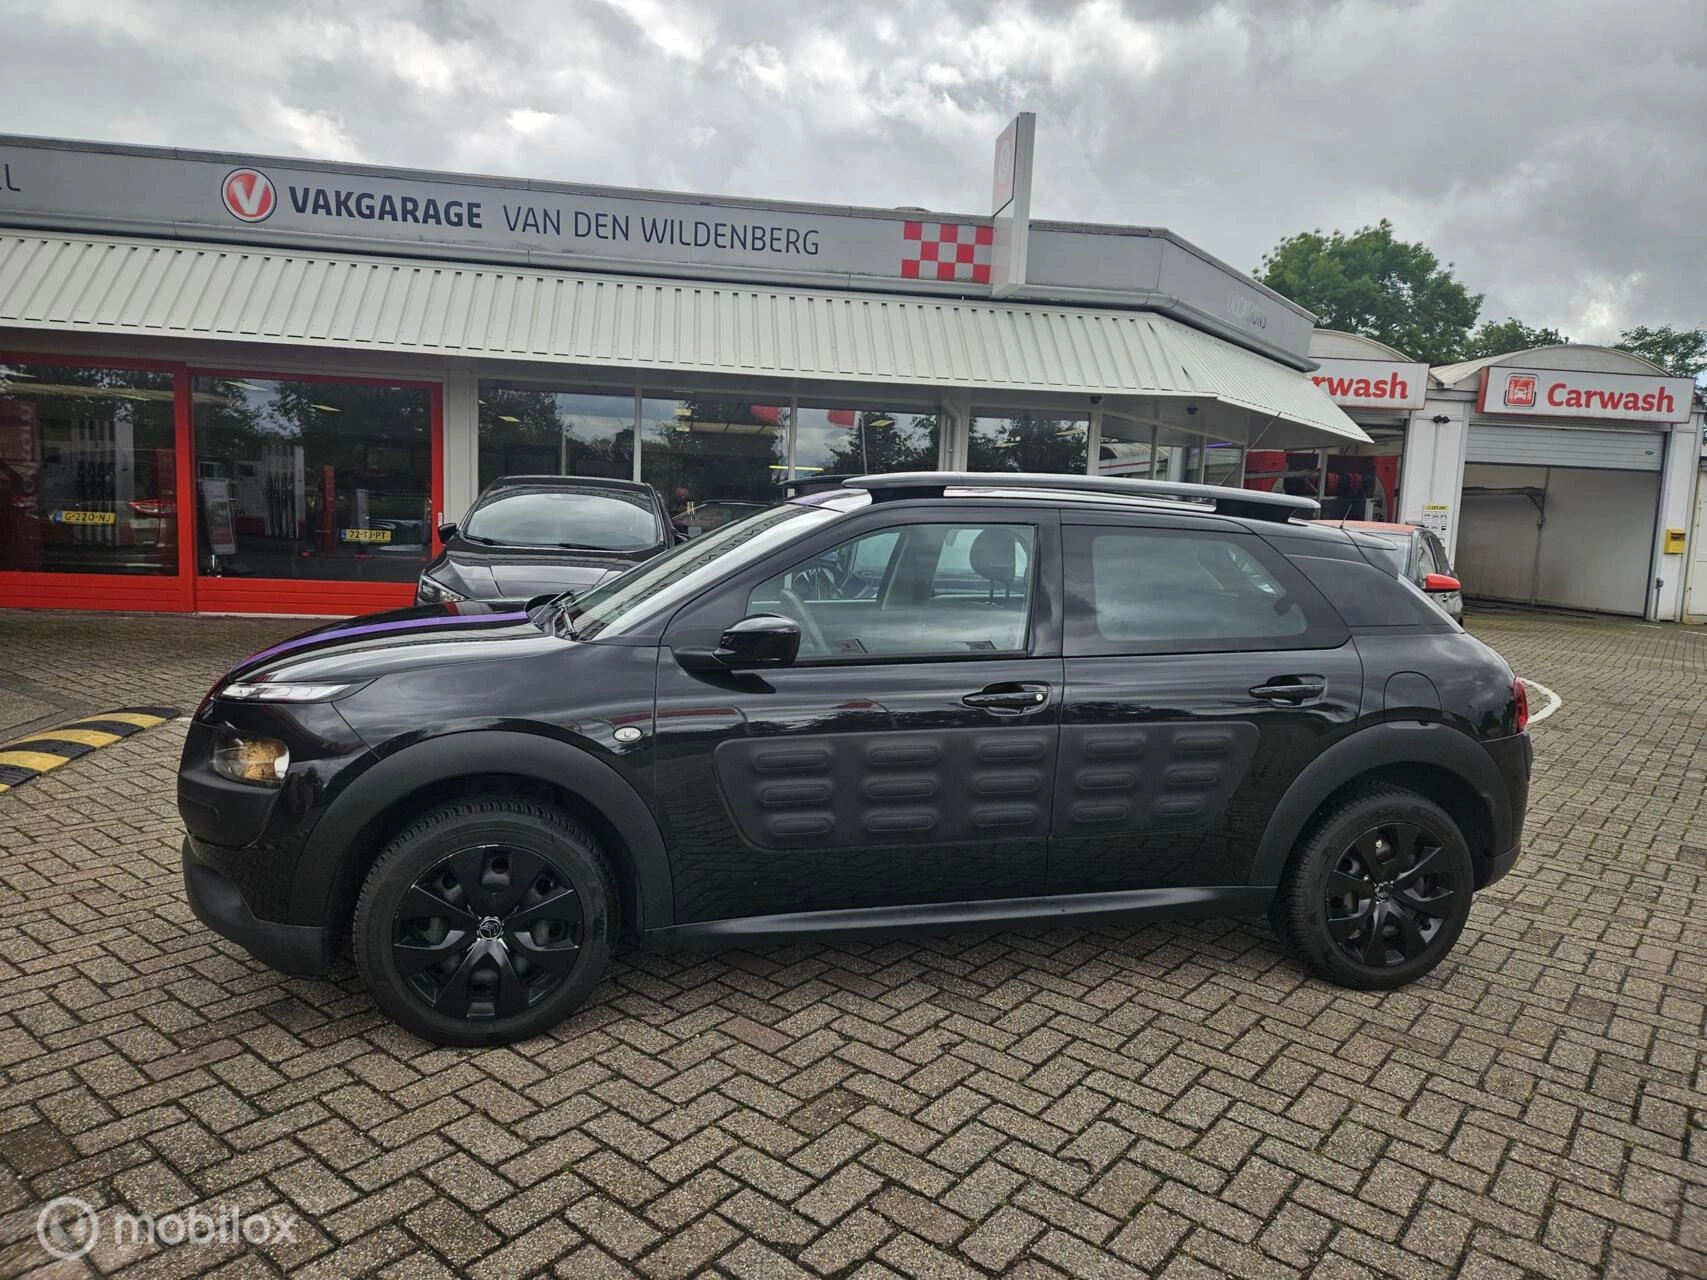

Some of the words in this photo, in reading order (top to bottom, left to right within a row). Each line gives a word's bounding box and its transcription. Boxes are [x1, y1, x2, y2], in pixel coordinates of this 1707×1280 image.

[288, 186, 482, 229] VAKGARAGE
[503, 205, 561, 235] VAN
[574, 211, 630, 241] DEN
[640, 216, 820, 255] WILDENBERG
[1547, 383, 1675, 413] Carwash
